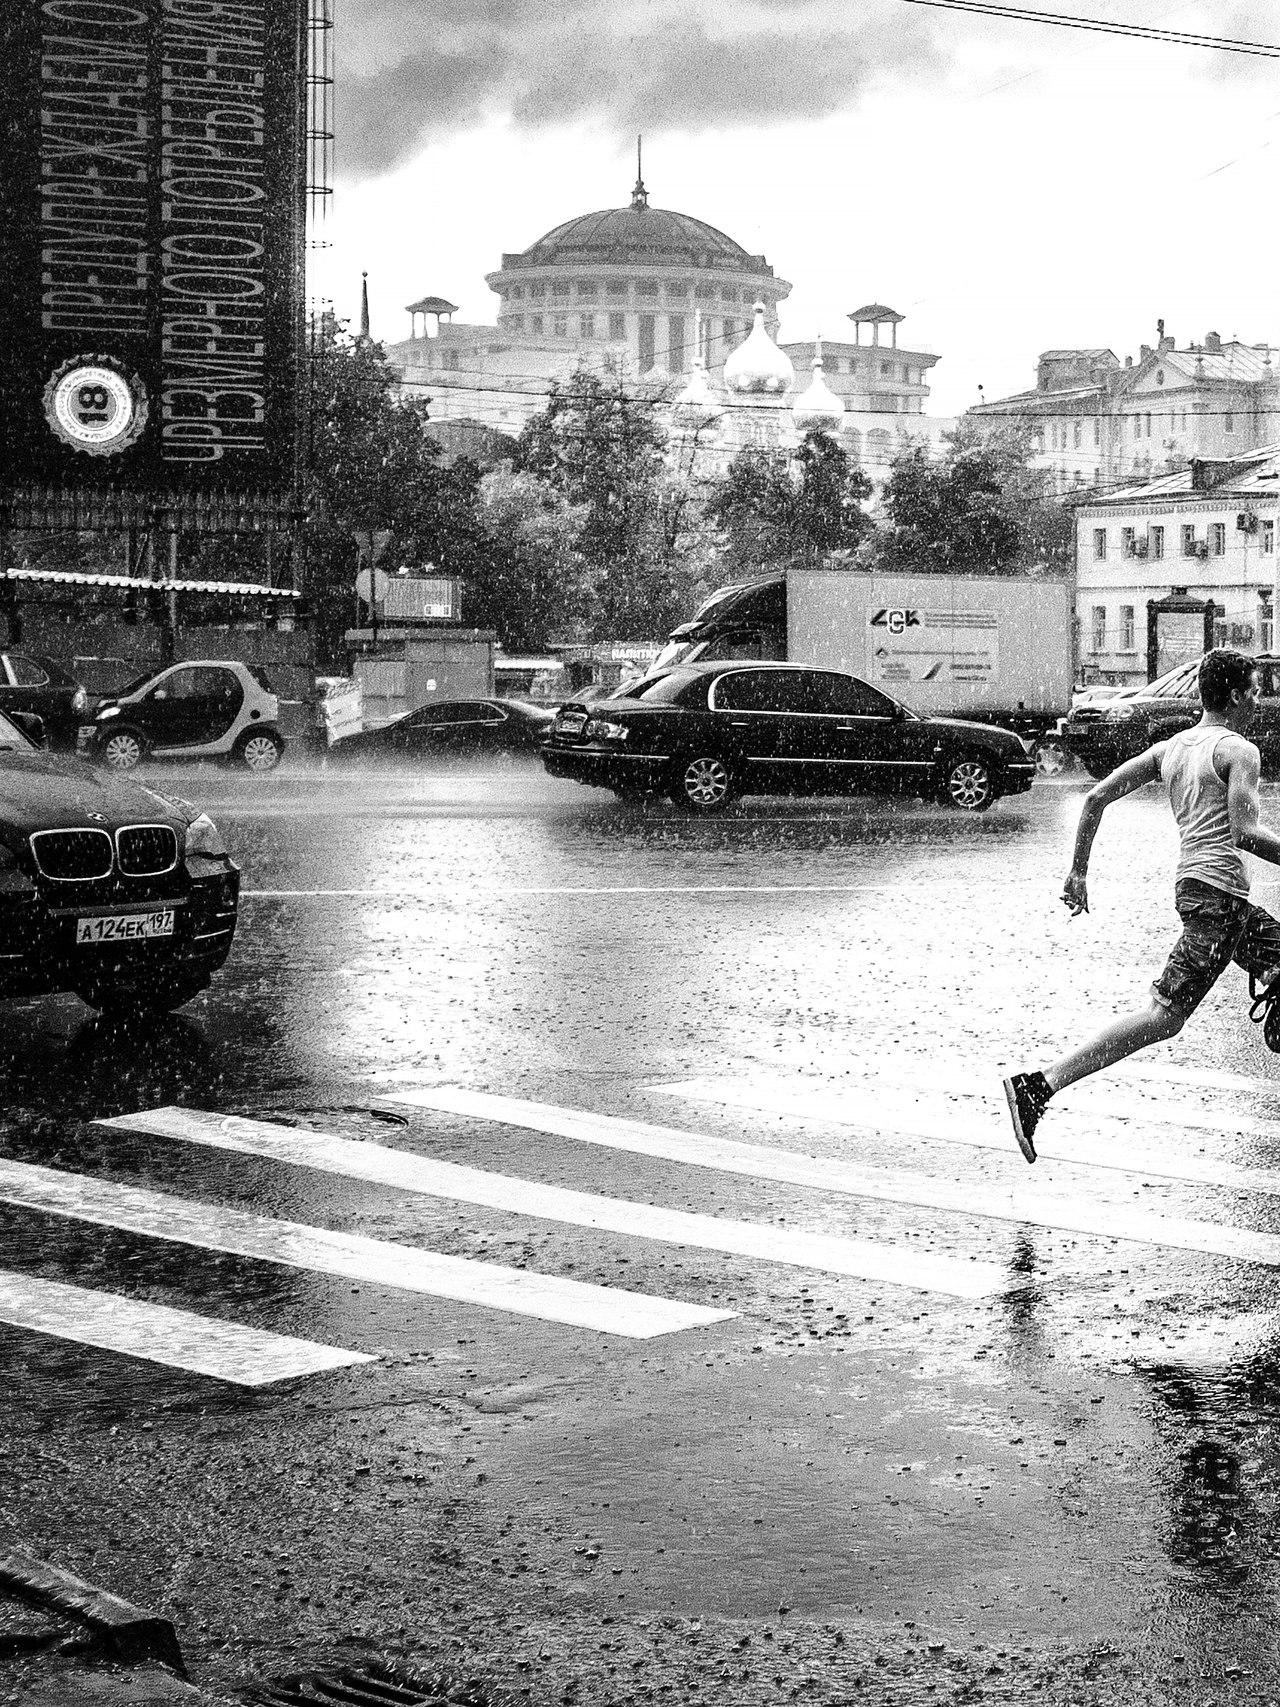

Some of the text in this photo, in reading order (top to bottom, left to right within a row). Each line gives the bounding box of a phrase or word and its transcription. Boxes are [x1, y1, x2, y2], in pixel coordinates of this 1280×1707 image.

[41, 2, 149, 26] О
[41, 34, 152, 333] ПРЕДУПРЕЖДАЕМ
[161, 0, 265, 462] ЧРЕЗМЕРНОГО ПОТРЕБЛЕНИЯ
[79, 385, 109, 426] 18
[149, 912, 172, 929] 197
